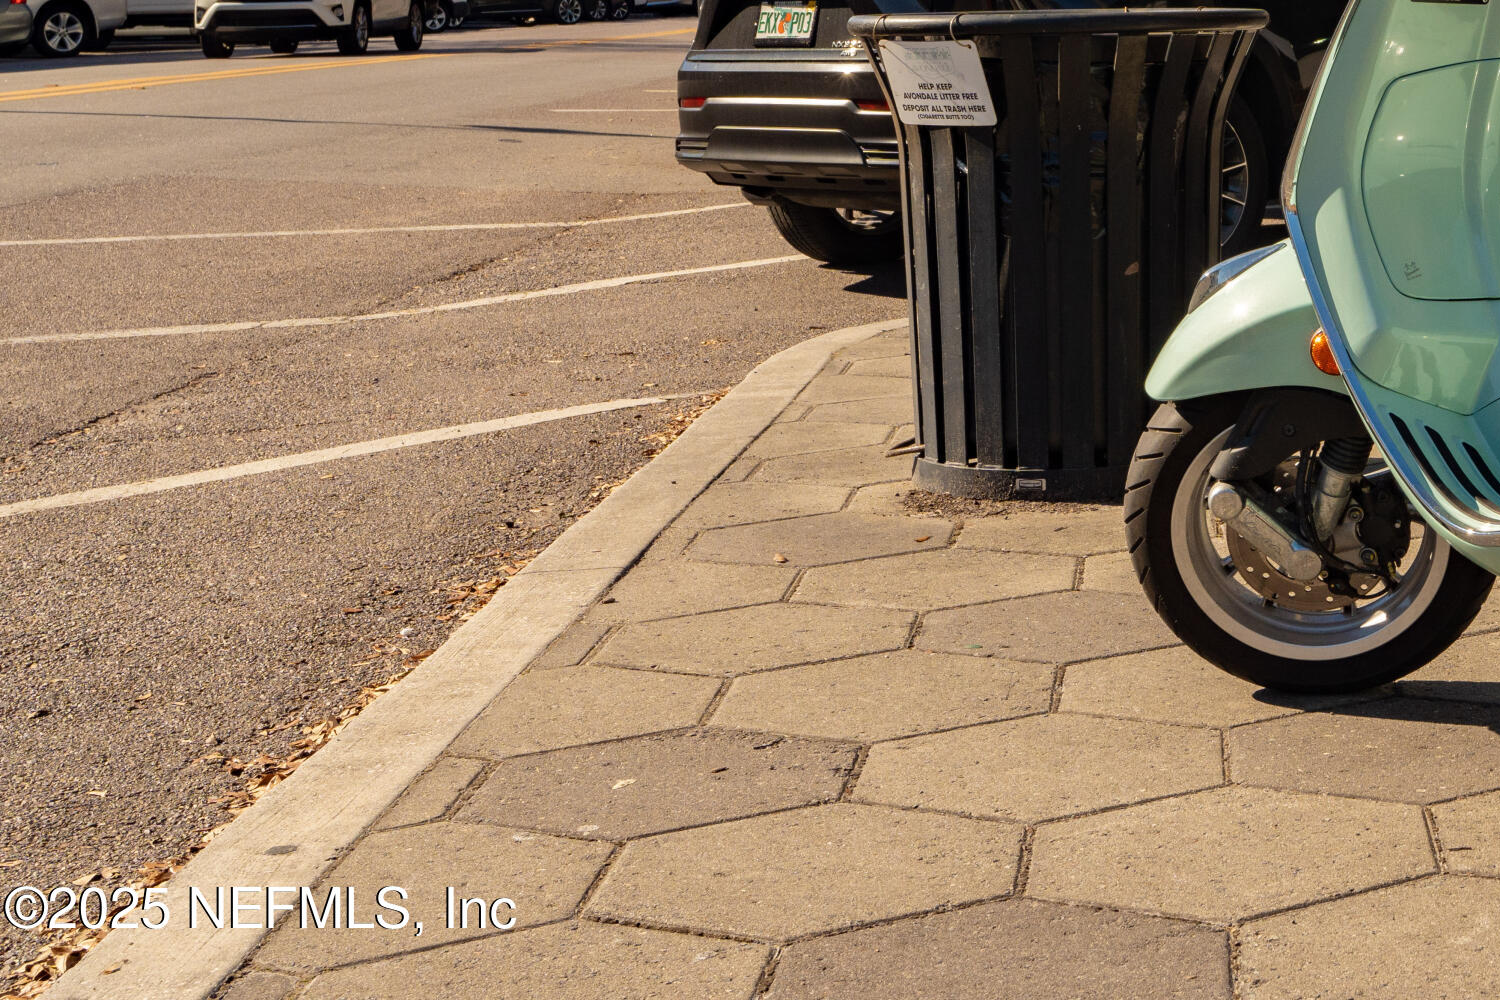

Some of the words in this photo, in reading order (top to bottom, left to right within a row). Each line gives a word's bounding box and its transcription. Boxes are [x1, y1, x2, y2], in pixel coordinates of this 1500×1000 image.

[757, 11, 780, 33] EKX
[903, 92, 939, 100] AVONDALE
[902, 104, 930, 112] DEPOSIT
[943, 105, 967, 113] TRASH
